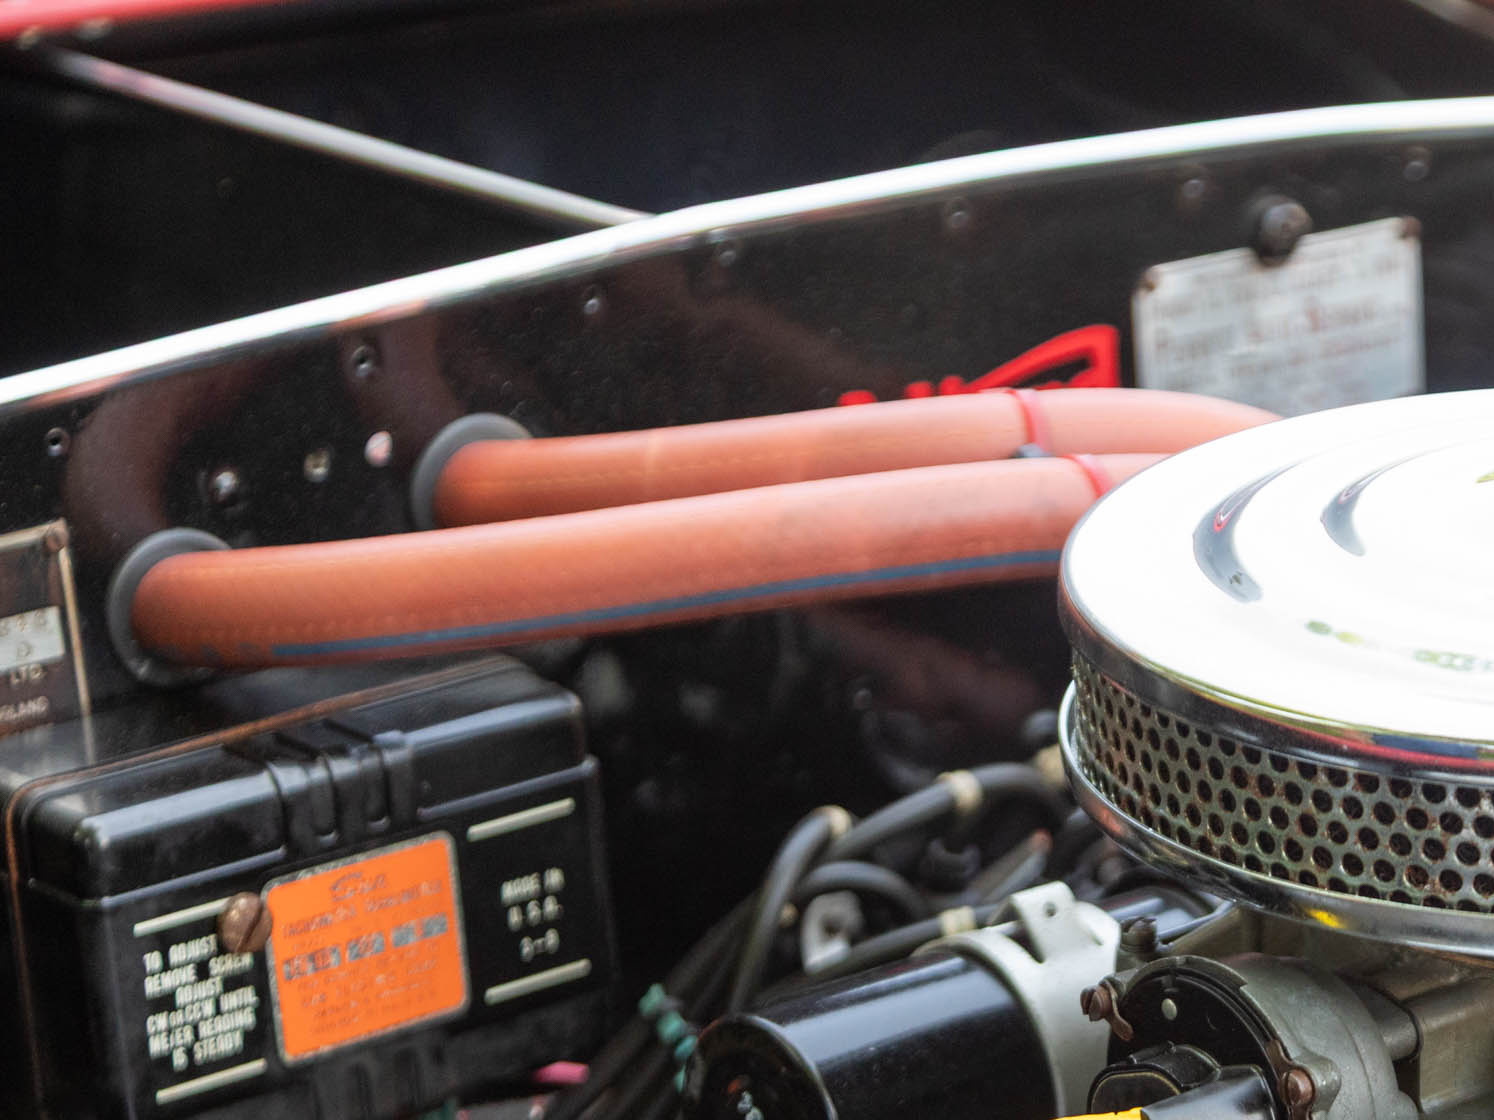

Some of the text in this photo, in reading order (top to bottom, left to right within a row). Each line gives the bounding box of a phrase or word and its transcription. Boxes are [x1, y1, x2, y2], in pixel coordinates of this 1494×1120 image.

[143, 933, 218, 974] TO ADJUST
[144, 963, 198, 1000] REMOVE
[175, 976, 223, 1008] ADJUST
[194, 1027, 244, 1066] STEADY
